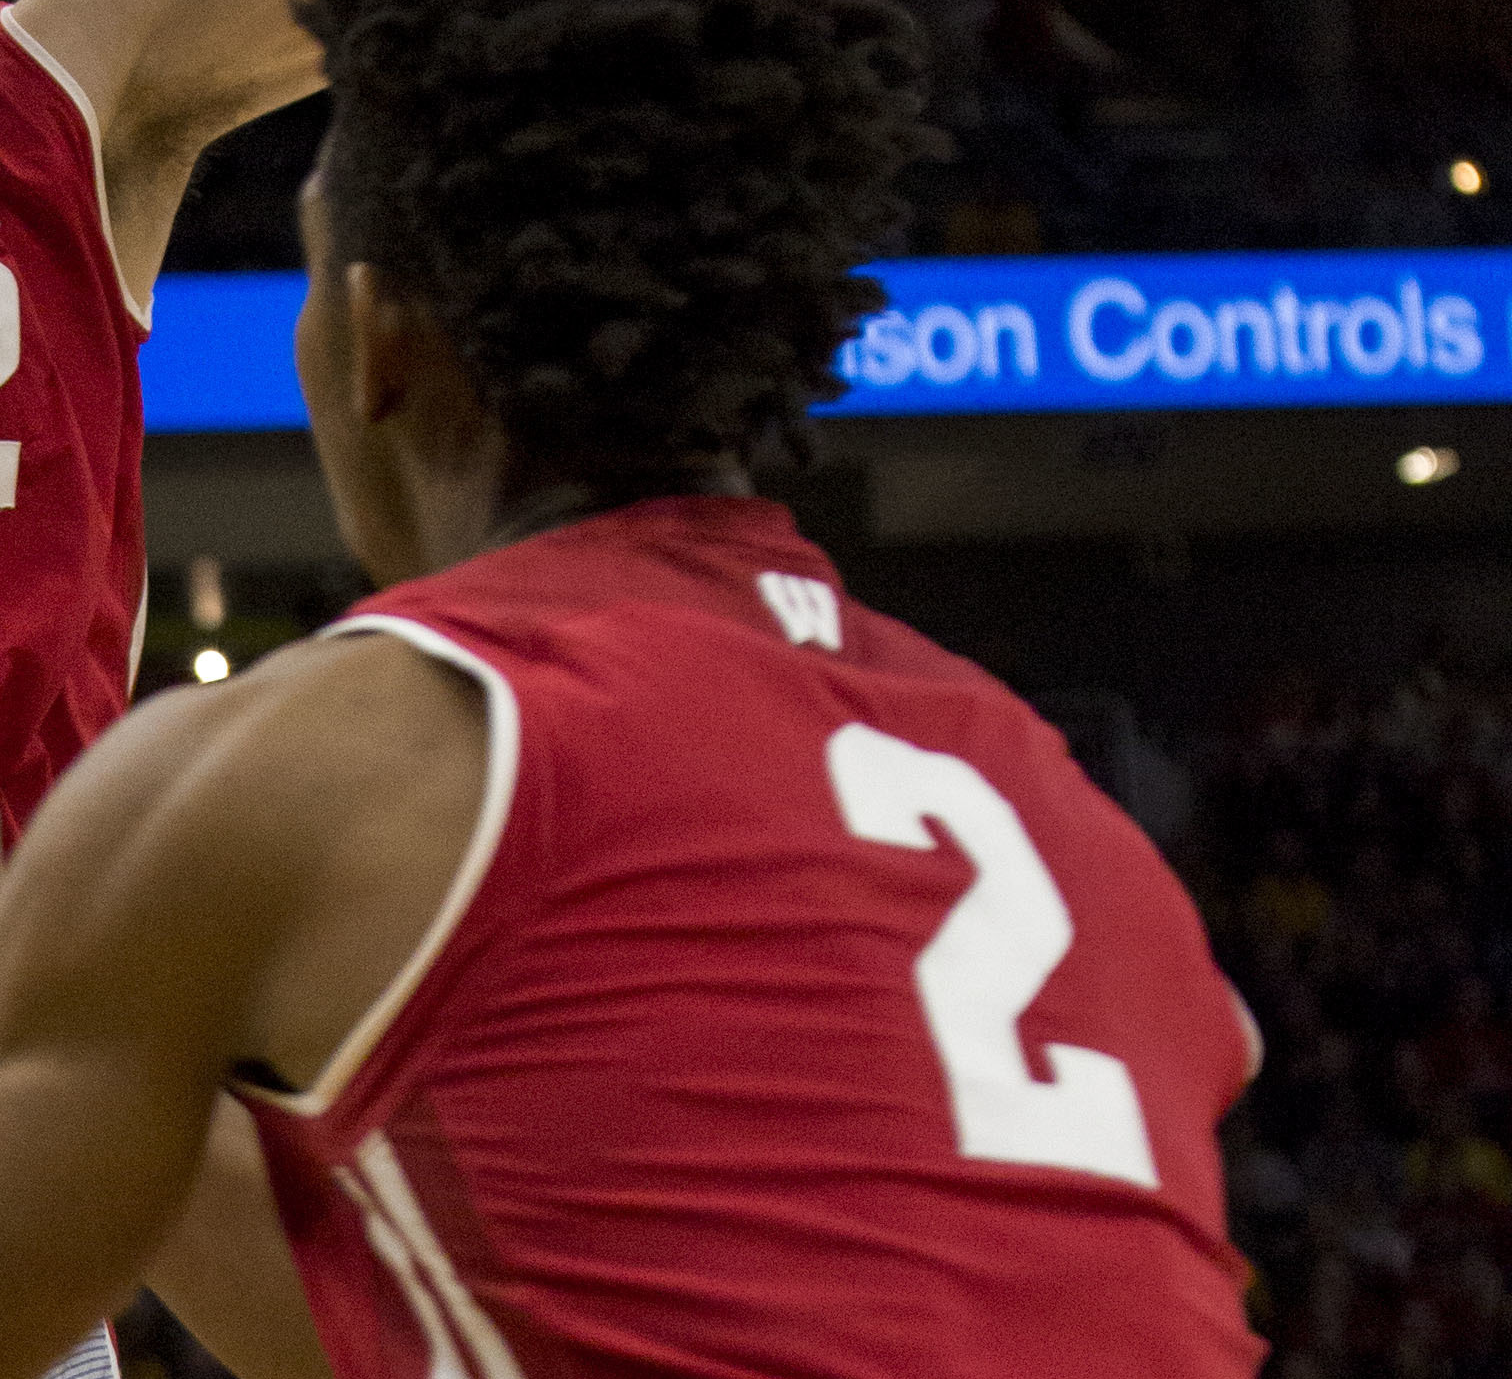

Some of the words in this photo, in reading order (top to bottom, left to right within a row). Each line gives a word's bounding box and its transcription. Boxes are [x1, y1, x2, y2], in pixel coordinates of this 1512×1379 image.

[838, 296, 1039, 386] son
[1070, 277, 1485, 381] Controls
[825, 722, 1160, 1189] 2
